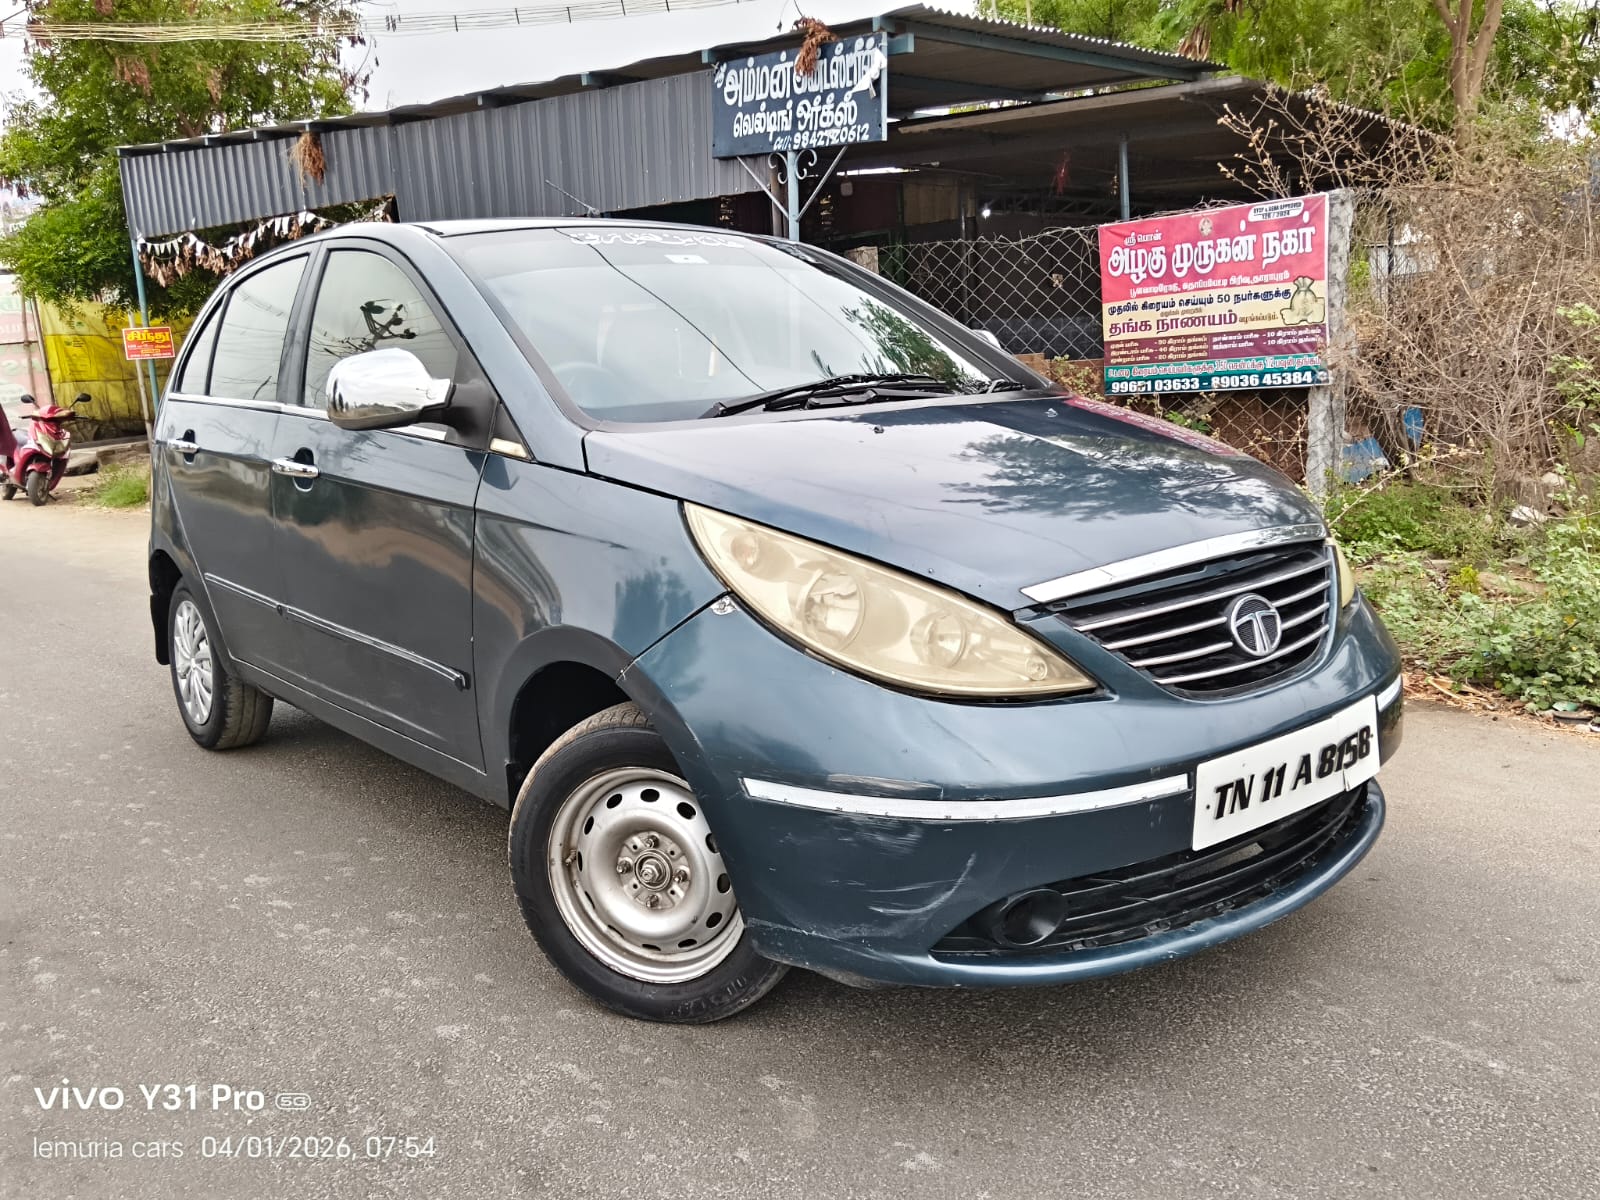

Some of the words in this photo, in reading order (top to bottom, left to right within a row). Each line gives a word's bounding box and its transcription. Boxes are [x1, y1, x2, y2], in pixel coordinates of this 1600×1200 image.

[723, 51, 793, 108] அம்மன்
[1108, 246, 1167, 284] அழகு
[1171, 220, 1257, 277] முருகன்
[1262, 211, 1316, 269] நகர்
[1108, 299, 1139, 316] முதலில்
[1141, 297, 1176, 312] கிரையம்
[1178, 294, 1214, 308] செய்யும்
[1217, 294, 1231, 303] 50
[1233, 287, 1292, 304] நபர்களுக்கு
[1109, 318, 1152, 338] தங்க
[1156, 309, 1238, 334] நாணயம்
[1154, 378, 1200, 392] 03633
[1211, 374, 1260, 389] 89036
[1262, 370, 1312, 386] 45384
[1214, 774, 1255, 820] TN
[1261, 762, 1288, 803] 11
[1292, 753, 1313, 791] A
[1317, 724, 1372, 779] 8158
